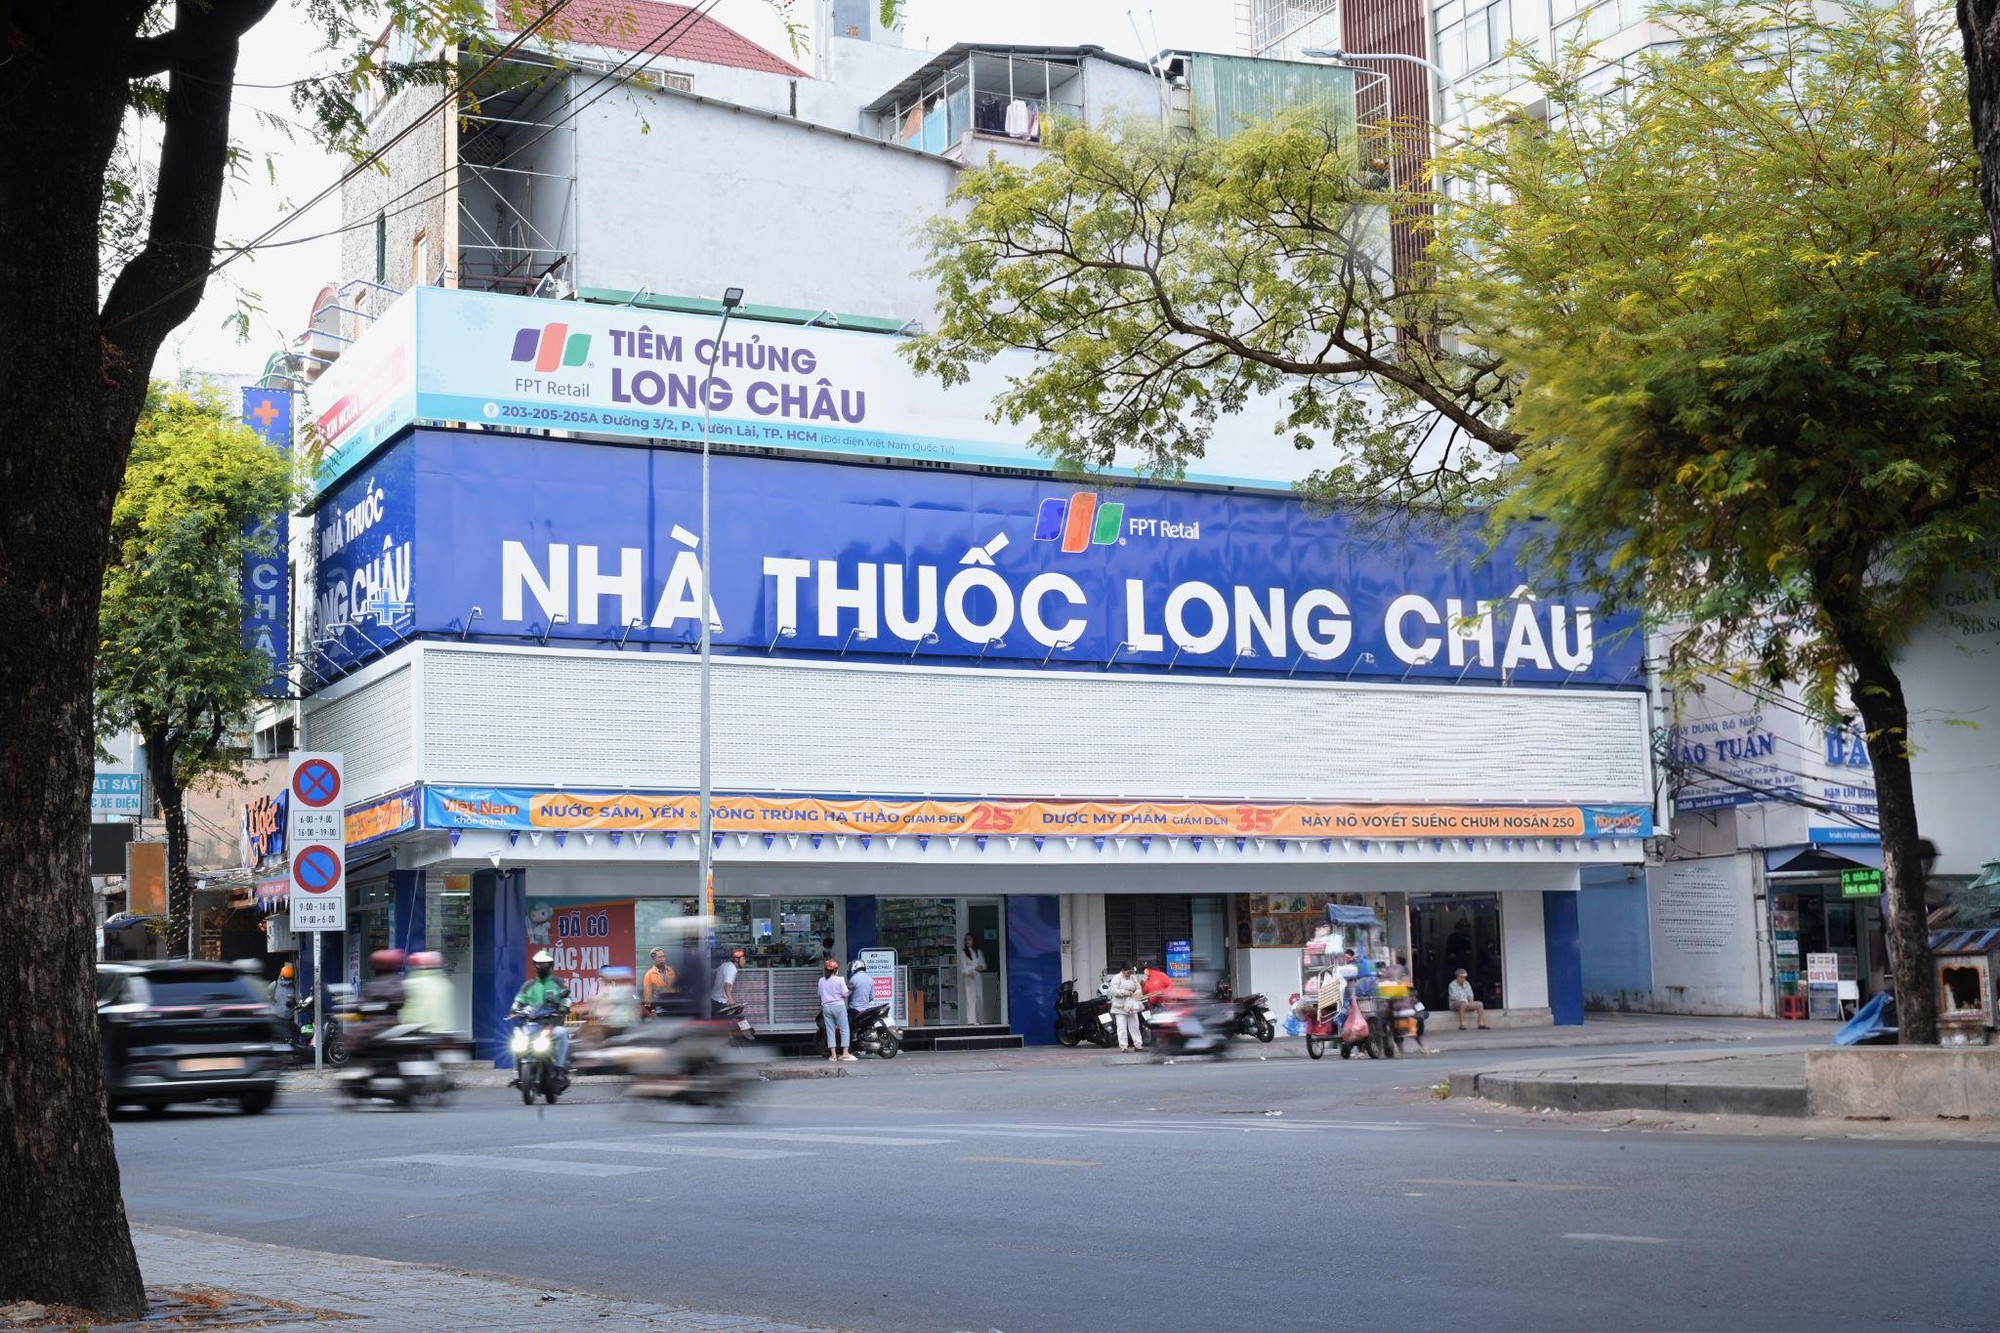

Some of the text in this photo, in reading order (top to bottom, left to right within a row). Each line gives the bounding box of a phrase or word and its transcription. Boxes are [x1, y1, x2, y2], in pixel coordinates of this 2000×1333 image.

[609, 325, 817, 375] TIÊM CHỦNG
[515, 378, 590, 398] FPT Retail
[612, 367, 866, 424] LONG CHÂU
[502, 405, 599, 424] 203-205-205A
[601, 414, 649, 430] Đường
[652, 417, 677, 432] 3/2,
[681, 422, 694, 432] P.
[762, 427, 783, 439] TP.
[786, 430, 817, 442] HCM
[888, 440, 911, 450] Nam
[321, 507, 344, 561] NHÀ
[345, 477, 384, 543] THUỐC
[1129, 518, 1200, 540] FPT Retail
[351, 534, 411, 622] CHÂU
[502, 524, 1594, 673] NHÀ THUỐC LONG CHÂU
[112, 775, 138, 790] SẤY
[100, 797, 112, 808] XE
[480, 800, 519, 816] Nam
[540, 803, 594, 818] NƯỚC
[599, 804, 644, 820] SÂM,
[649, 804, 685, 818] YẾN
[689, 810, 698, 819] &
[760, 806, 818, 821] TRÙNG
[1042, 811, 1090, 827] DƯỢC
[1552, 817, 1575, 828] 250
[559, 910, 609, 939] ĐÃ CÓ
[580, 946, 610, 971] XIN
